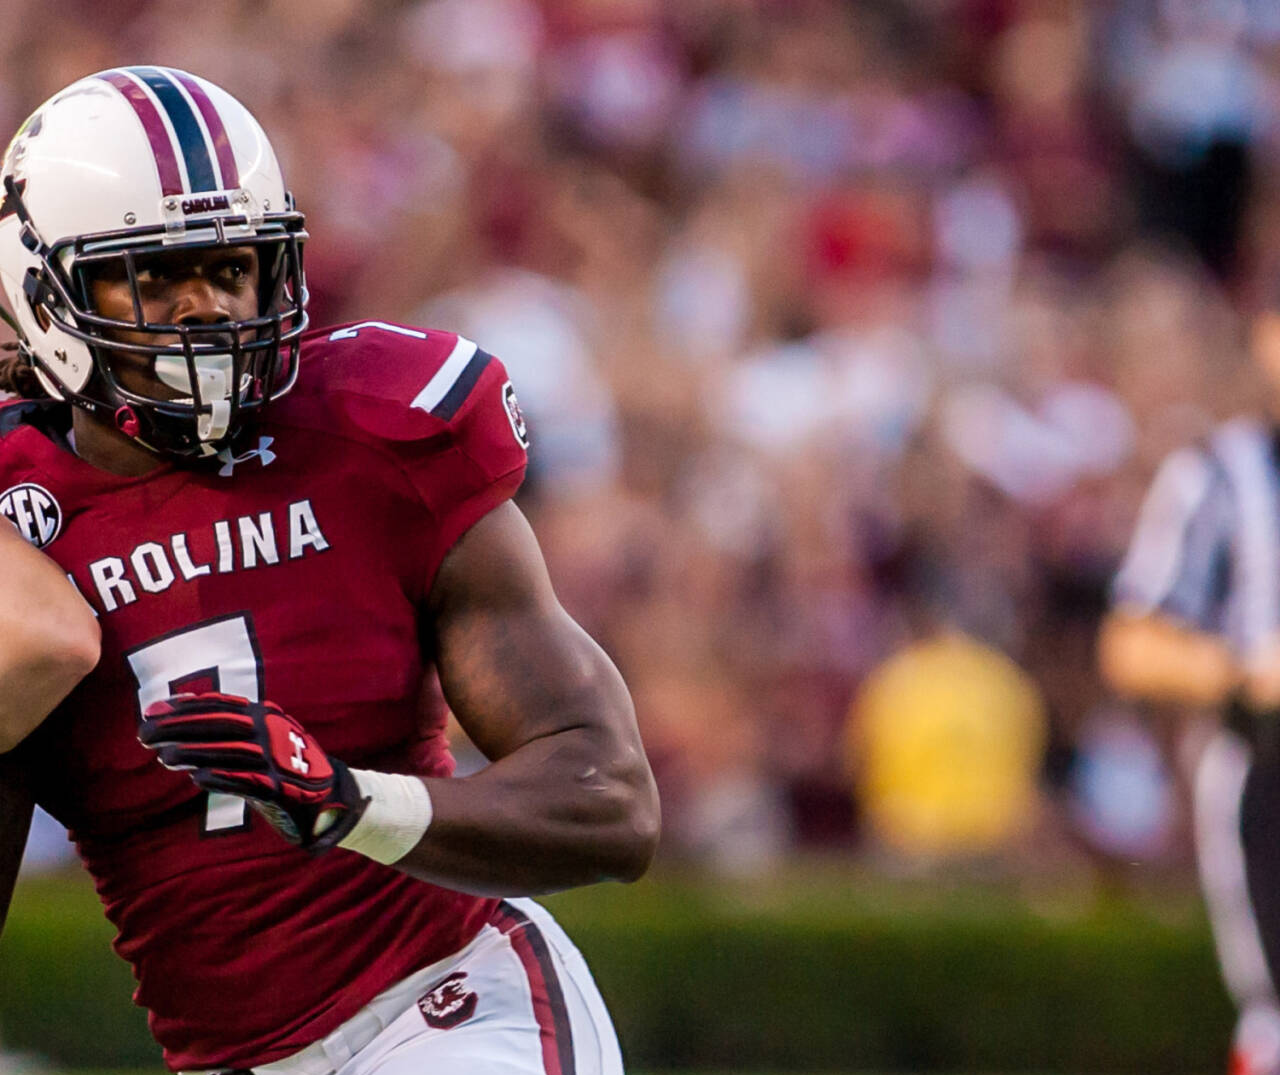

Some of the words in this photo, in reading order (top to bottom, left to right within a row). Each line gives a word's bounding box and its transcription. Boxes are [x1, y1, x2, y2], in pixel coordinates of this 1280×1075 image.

[181, 195, 231, 216] CAROLINA
[68, 499, 331, 617] ROLINA
[126, 614, 260, 833] 7
